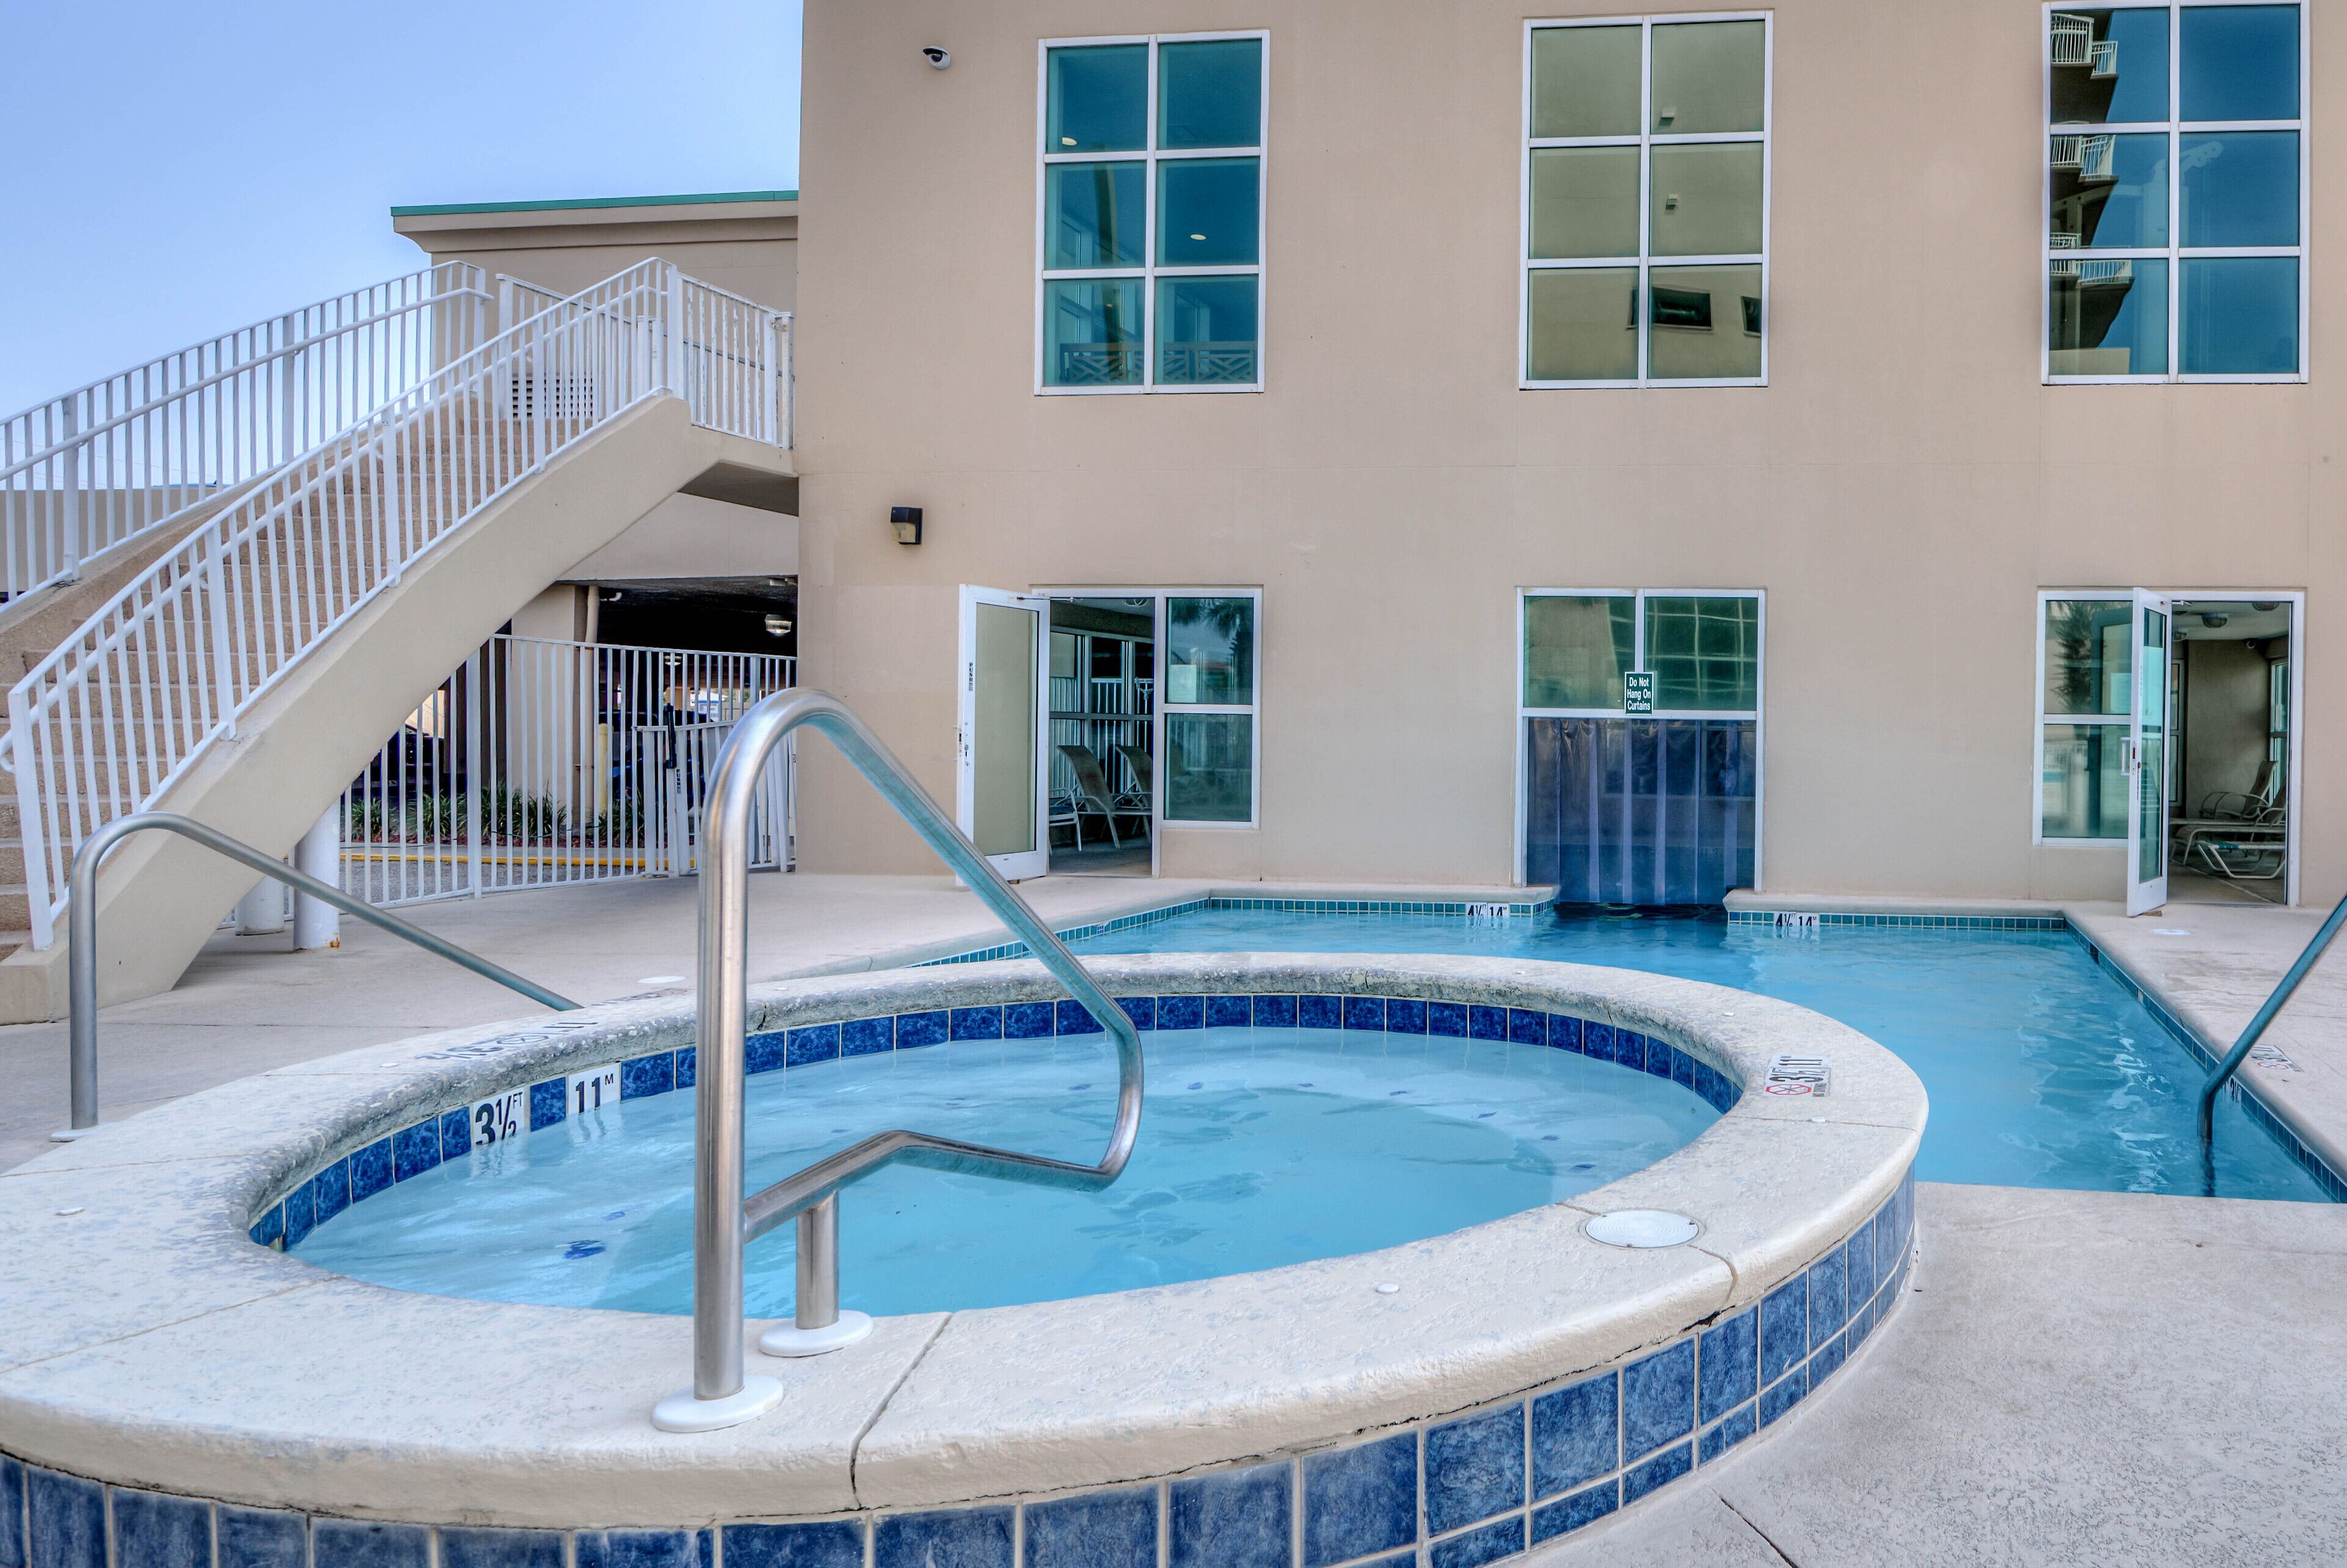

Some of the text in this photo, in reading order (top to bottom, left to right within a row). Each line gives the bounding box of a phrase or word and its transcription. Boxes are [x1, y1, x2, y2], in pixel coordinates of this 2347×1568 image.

[1629, 677, 1649, 687] Do Not
[1627, 689, 1651, 700] Hang On
[1627, 700, 1651, 711] Curtains
[576, 1074, 614, 1114] 11 M
[513, 1092, 523, 1108] FT
